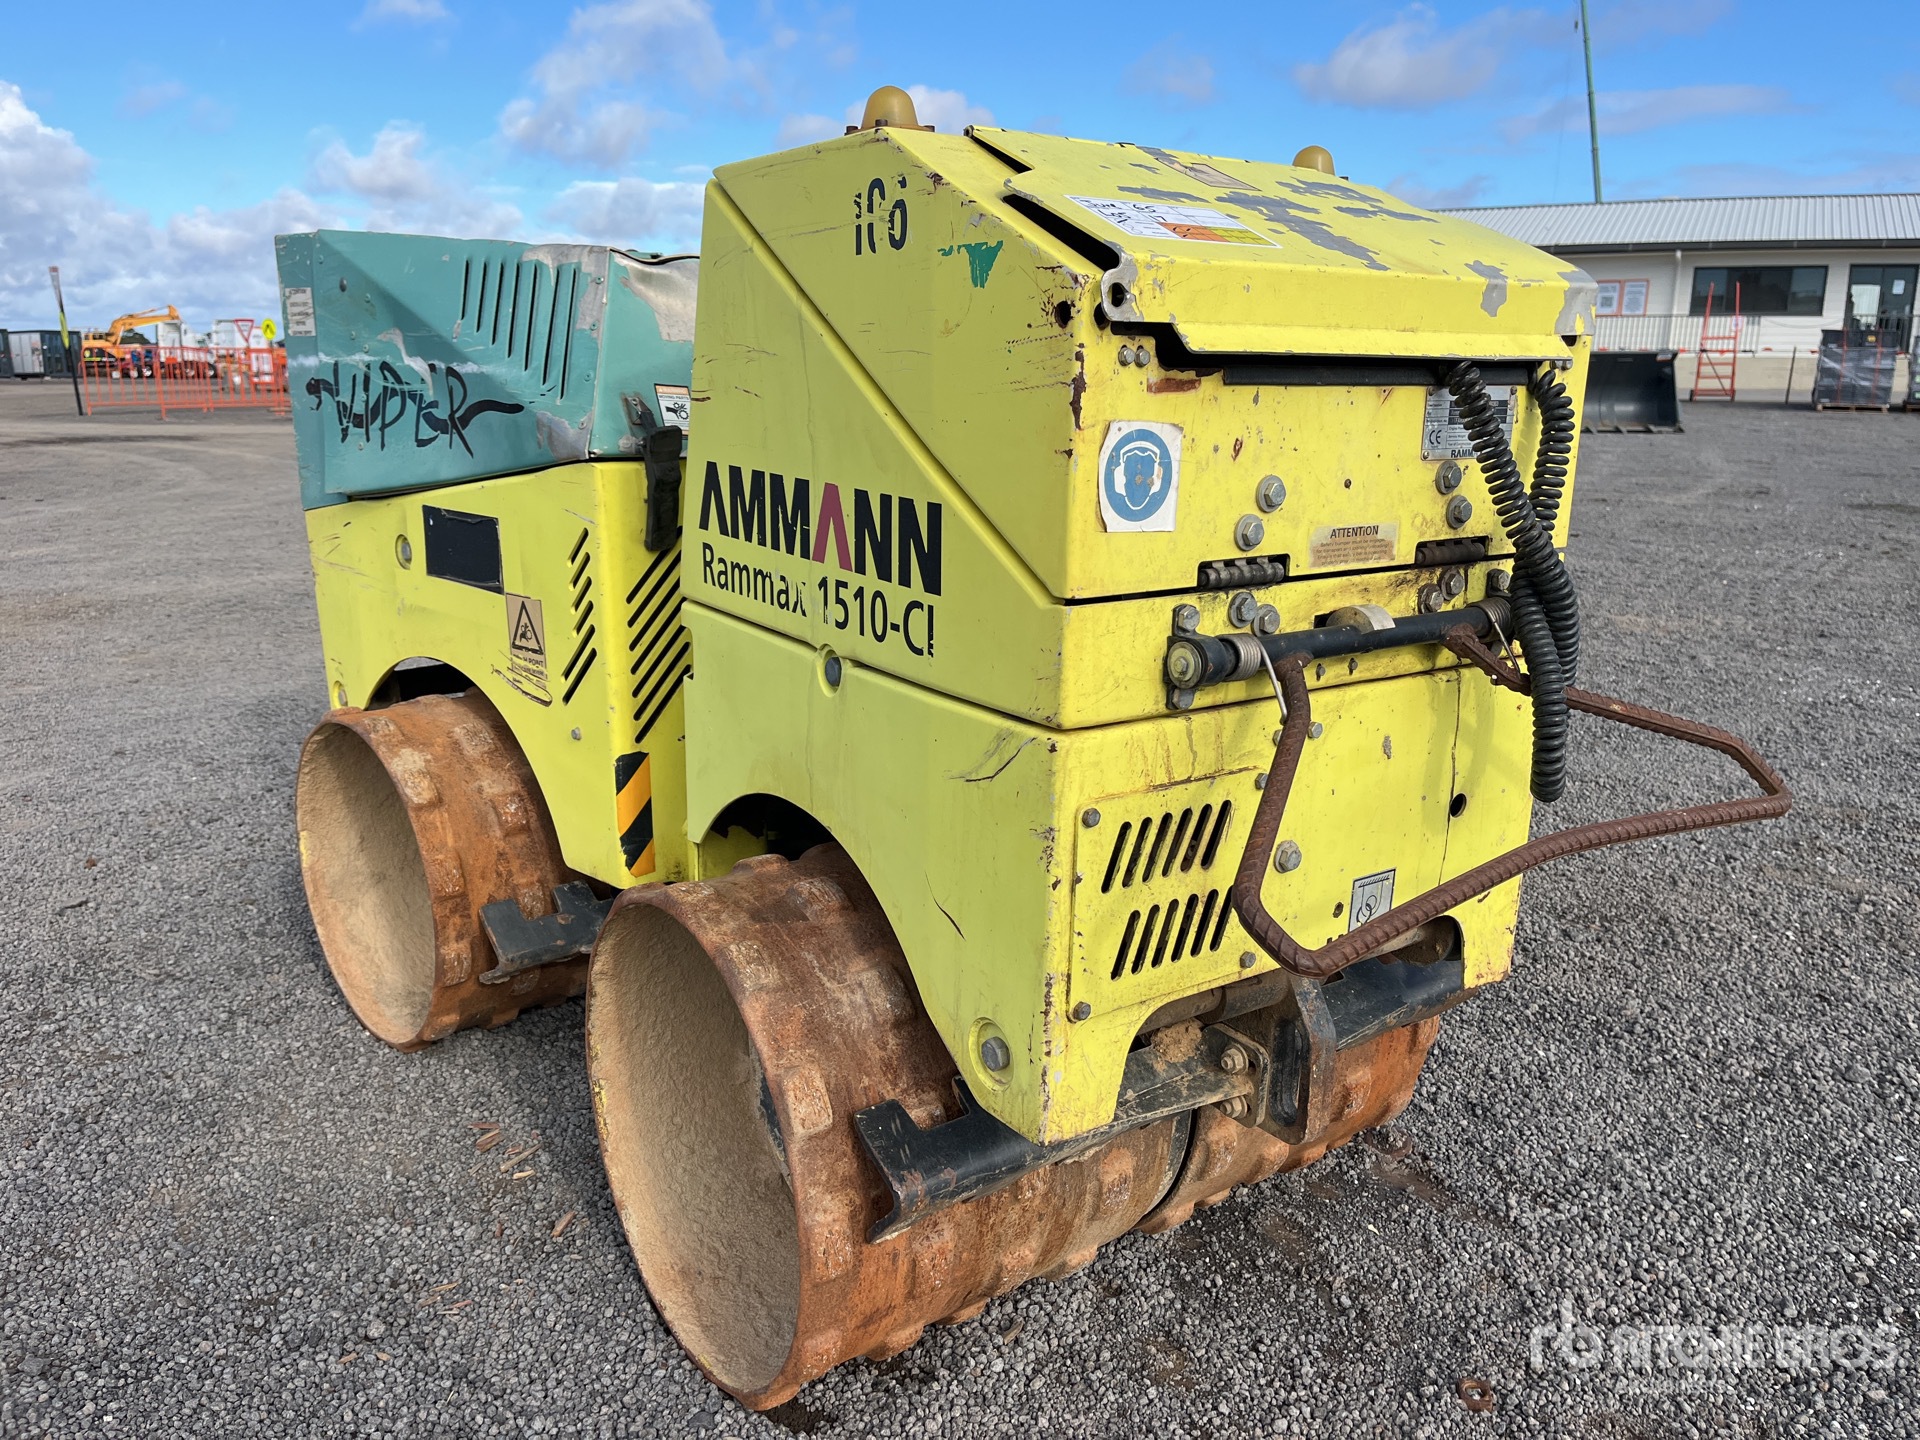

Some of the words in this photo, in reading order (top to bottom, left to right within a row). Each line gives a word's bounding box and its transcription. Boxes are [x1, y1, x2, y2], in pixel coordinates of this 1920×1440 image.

[331, 360, 475, 460] VIPER
[698, 460, 942, 597] AMMANN
[702, 542, 807, 618] Rammax
